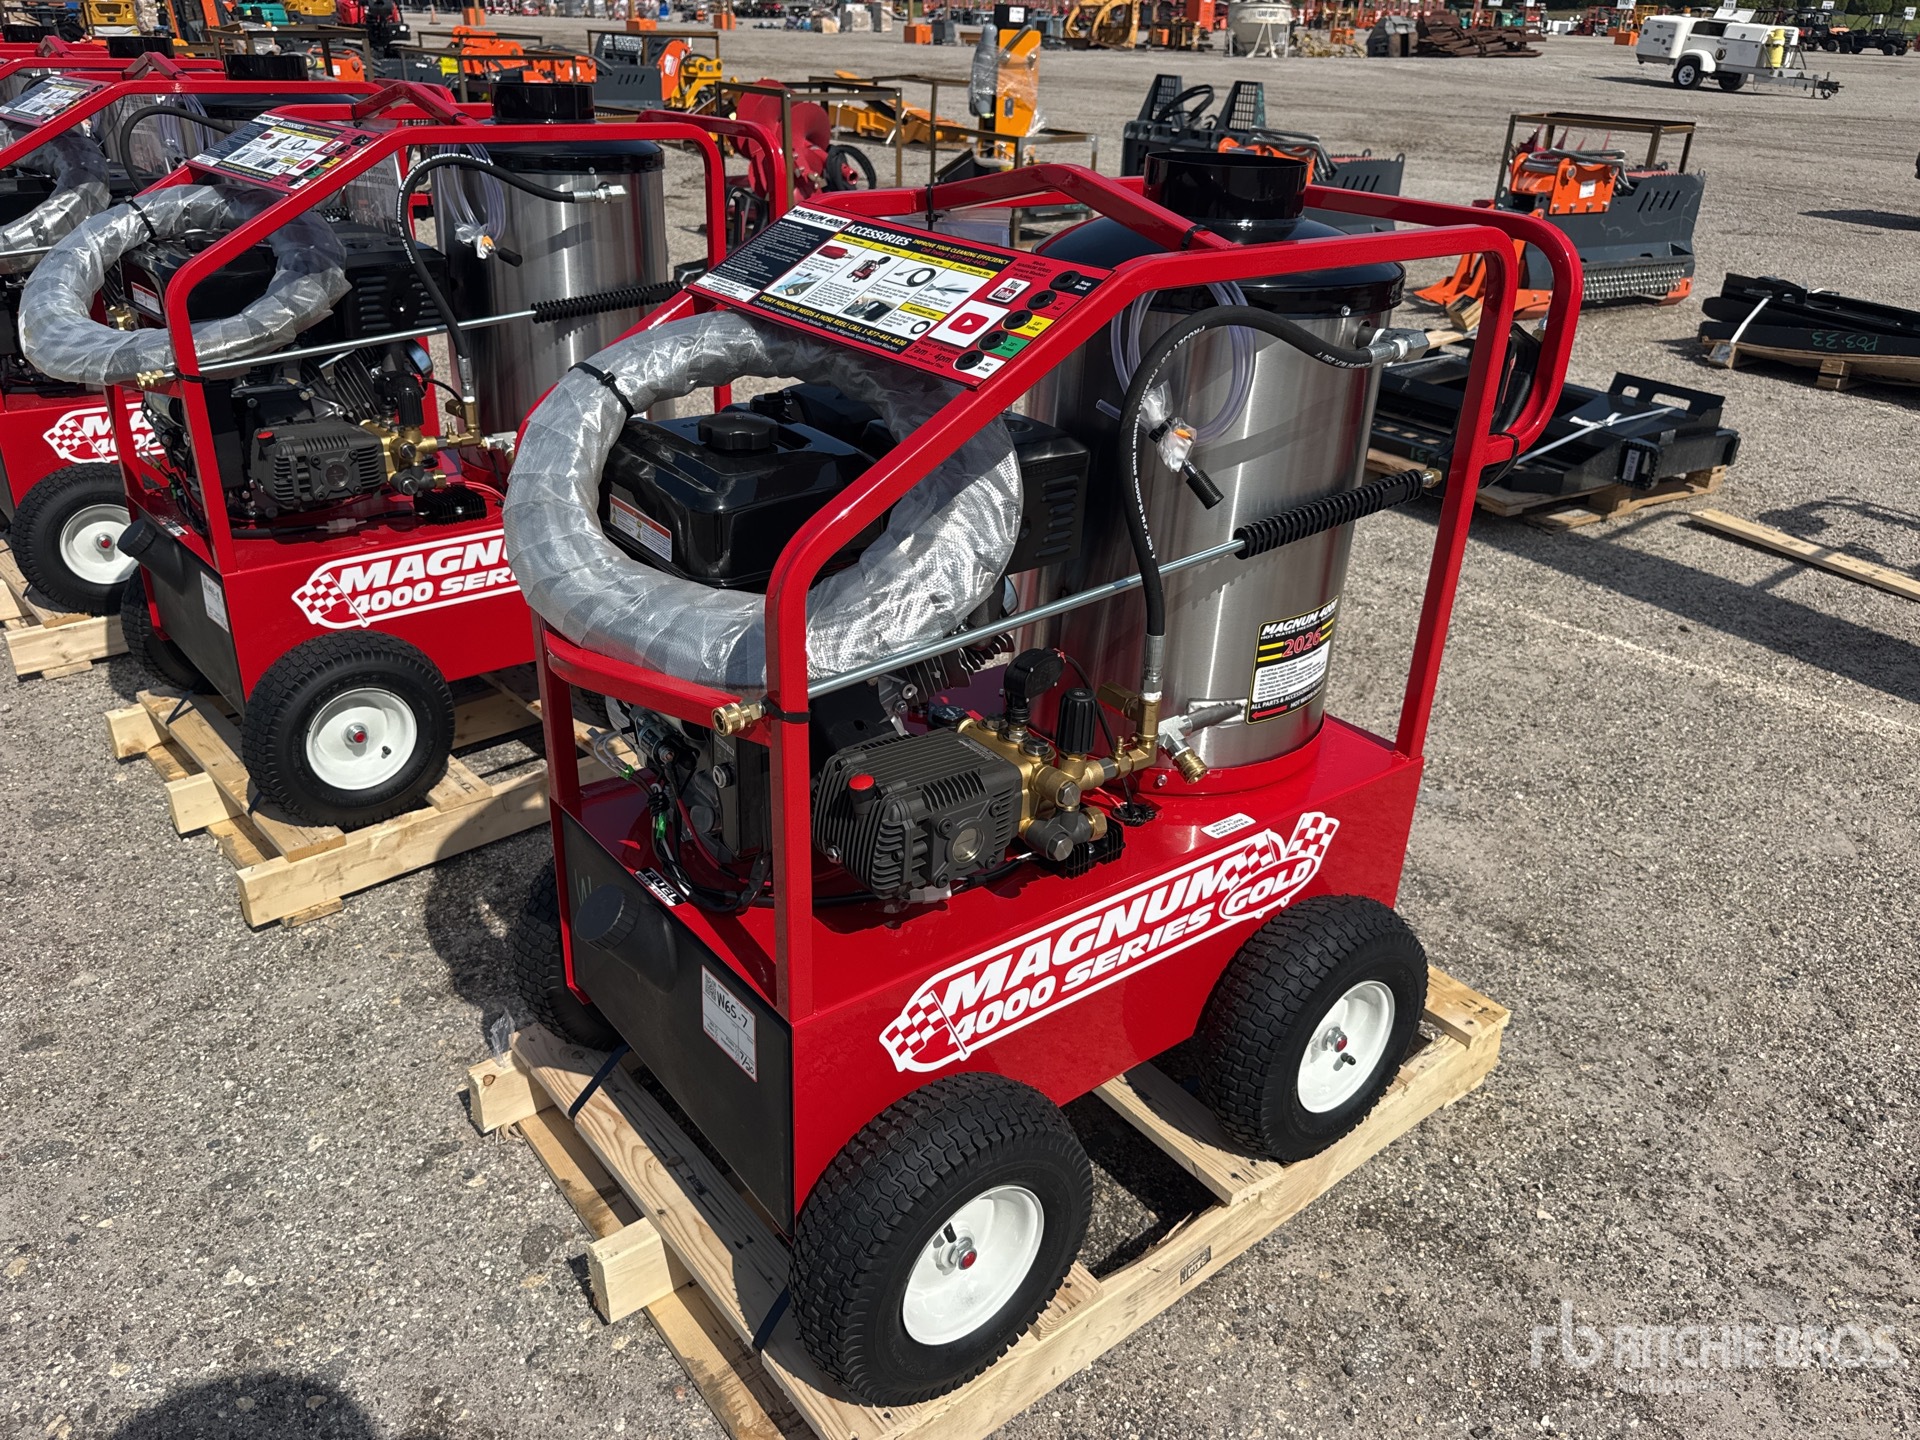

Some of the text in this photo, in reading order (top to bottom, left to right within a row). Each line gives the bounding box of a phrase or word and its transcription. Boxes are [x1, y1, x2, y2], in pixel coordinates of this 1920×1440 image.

[789, 208, 829, 221] MAGNUM
[842, 224, 915, 246] ACCESSORIES
[910, 239, 938, 248] IMPROVE
[947, 247, 979, 258] CLEANING
[974, 253, 1011, 265] EFFICIENCY
[992, 280, 1024, 299] You Tube
[758, 294, 778, 304] EVERY
[773, 299, 800, 311] MACHINE
[795, 307, 817, 317] NEEDS
[816, 314, 836, 323] HOSE
[846, 323, 865, 332] CALL
[908, 345, 930, 355] 7am
[929, 352, 954, 365] 4pm
[935, 345, 961, 356] Operation
[349, 582, 434, 615] 4000
[1260, 610, 1320, 636] MAGNUM
[1274, 630, 1296, 638] WATER
[1296, 620, 1320, 633] PRESSURE
[1282, 626, 1322, 658] 2026
[1250, 702, 1262, 710] ALL
[1262, 698, 1280, 708] PARTS
[1210, 818, 1244, 833] BACK FLOW
[1212, 818, 1234, 828] INSTALL
[1216, 820, 1250, 836] PREVENTER
[645, 872, 677, 902] FUEL
[1225, 862, 1309, 914] GOLD
[942, 853, 1245, 1017] MAGNUM
[948, 903, 1215, 1045] 4000 SERIES
